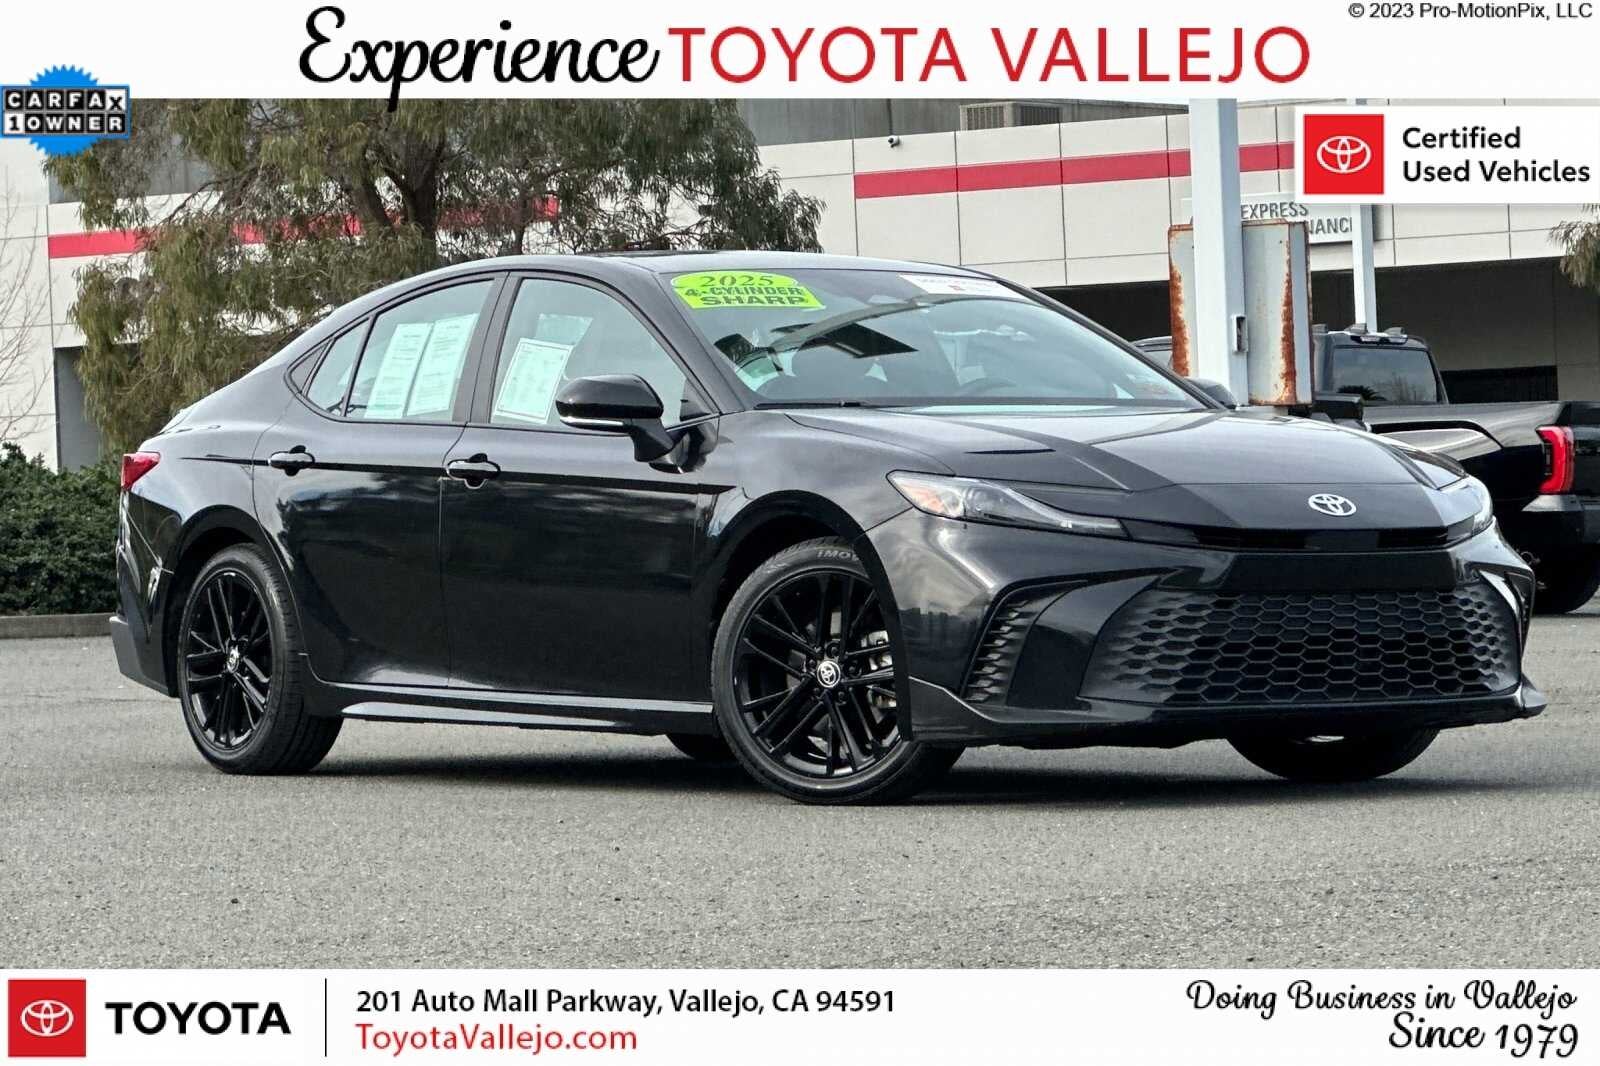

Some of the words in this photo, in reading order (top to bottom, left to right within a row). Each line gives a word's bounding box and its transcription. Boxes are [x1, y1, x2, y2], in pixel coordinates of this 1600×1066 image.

[1240, 201, 1309, 220] EXPRESS
[700, 275, 775, 287] 2025
[684, 286, 804, 297] 4-CYLINDER
[700, 295, 809, 306] SHARP
